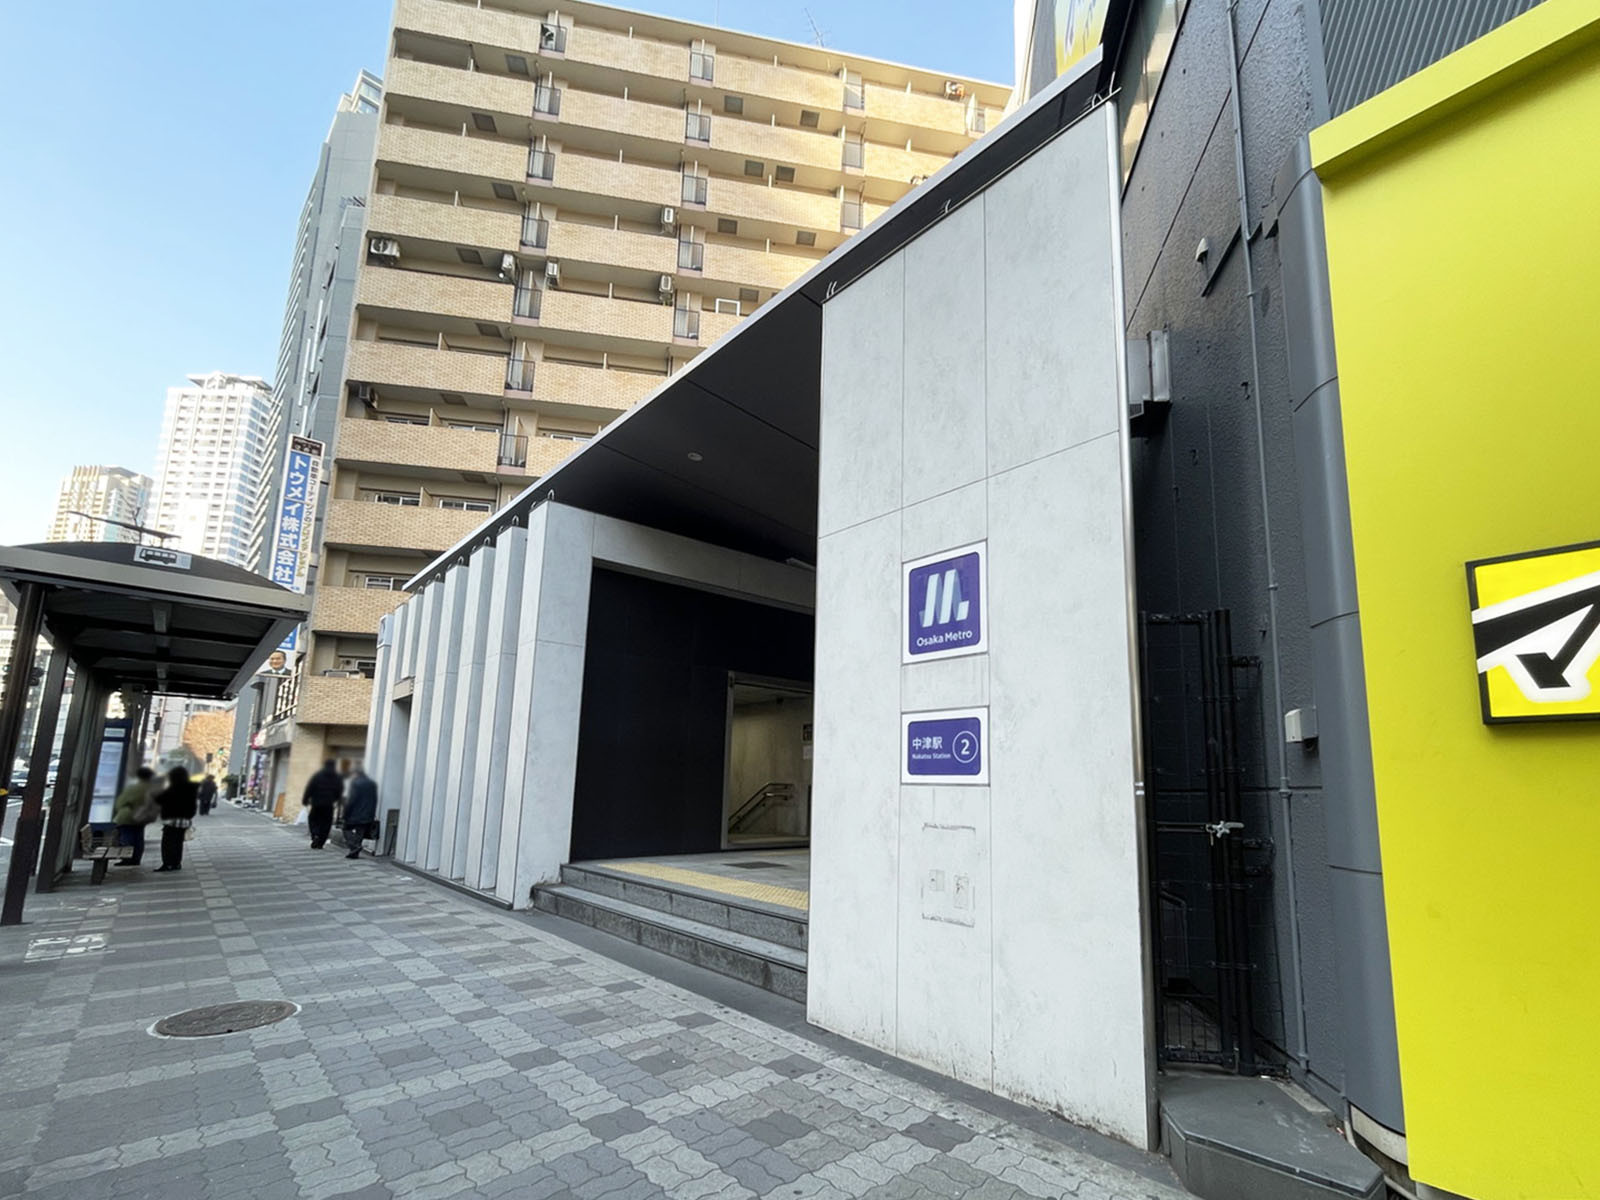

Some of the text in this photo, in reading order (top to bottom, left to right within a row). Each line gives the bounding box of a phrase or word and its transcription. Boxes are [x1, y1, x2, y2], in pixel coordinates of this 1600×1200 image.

[275, 455, 307, 582] トウメイ株式会社
[917, 630, 973, 647] Osaka Metro
[912, 736, 943, 750] 中津駅
[961, 738, 970, 755] 2
